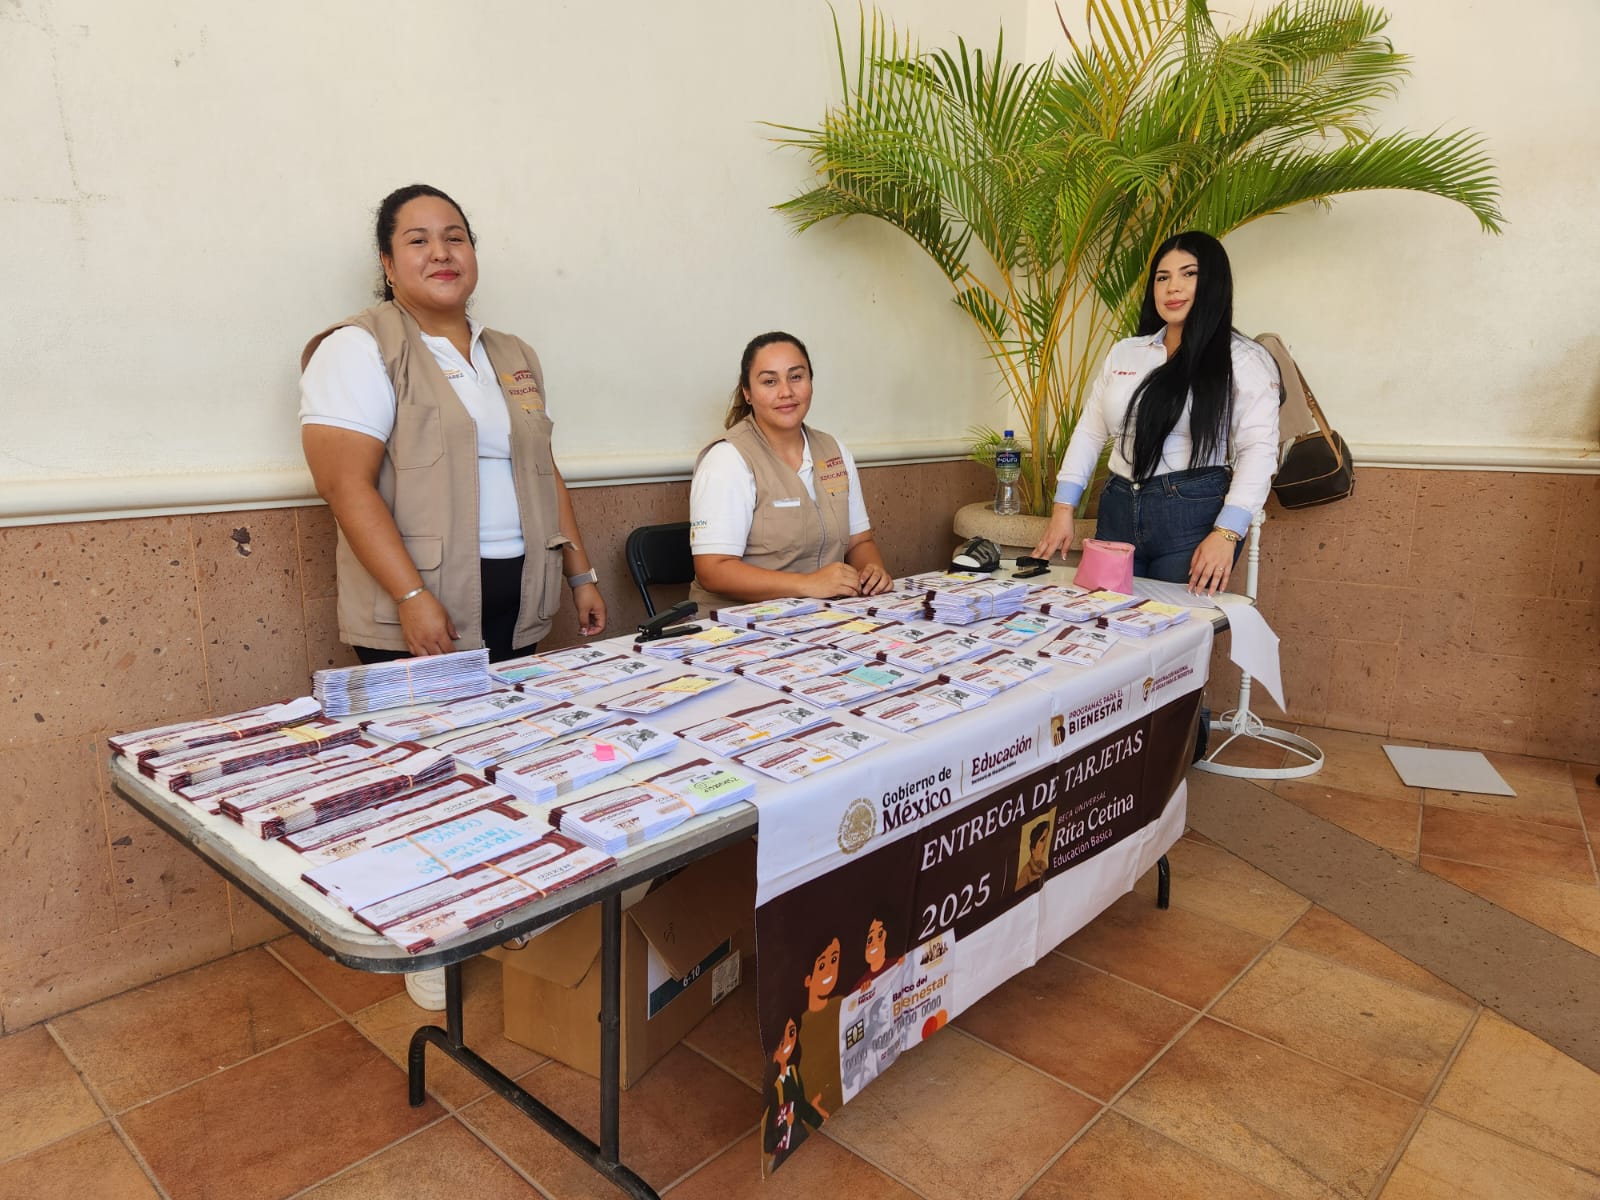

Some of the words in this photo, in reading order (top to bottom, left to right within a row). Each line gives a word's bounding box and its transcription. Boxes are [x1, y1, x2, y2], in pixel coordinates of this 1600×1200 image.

[1068, 699, 1103, 720] PROGRAMAS
[1103, 692, 1117, 705] PARA
[1117, 688, 1124, 698] EL
[1069, 698, 1123, 735] BIENESTAR
[971, 734, 1032, 777] Educación
[882, 775, 936, 808] Gobierno
[938, 766, 952, 782] de
[920, 793, 1026, 872] ENTREGA
[1031, 775, 1060, 810] DE
[1063, 729, 1144, 792] TARJETAS
[1057, 809, 1073, 824] BECA
[1074, 791, 1107, 814] UNIVERSAL
[881, 787, 952, 835] México
[1053, 820, 1085, 852] Rita
[1087, 793, 1134, 831] Cetina
[918, 872, 991, 940] 2025
[683, 964, 701, 987] 6-10
[893, 974, 949, 1017] Benestar
[916, 975, 928, 988] del
[921, 994, 942, 1018] 0000
